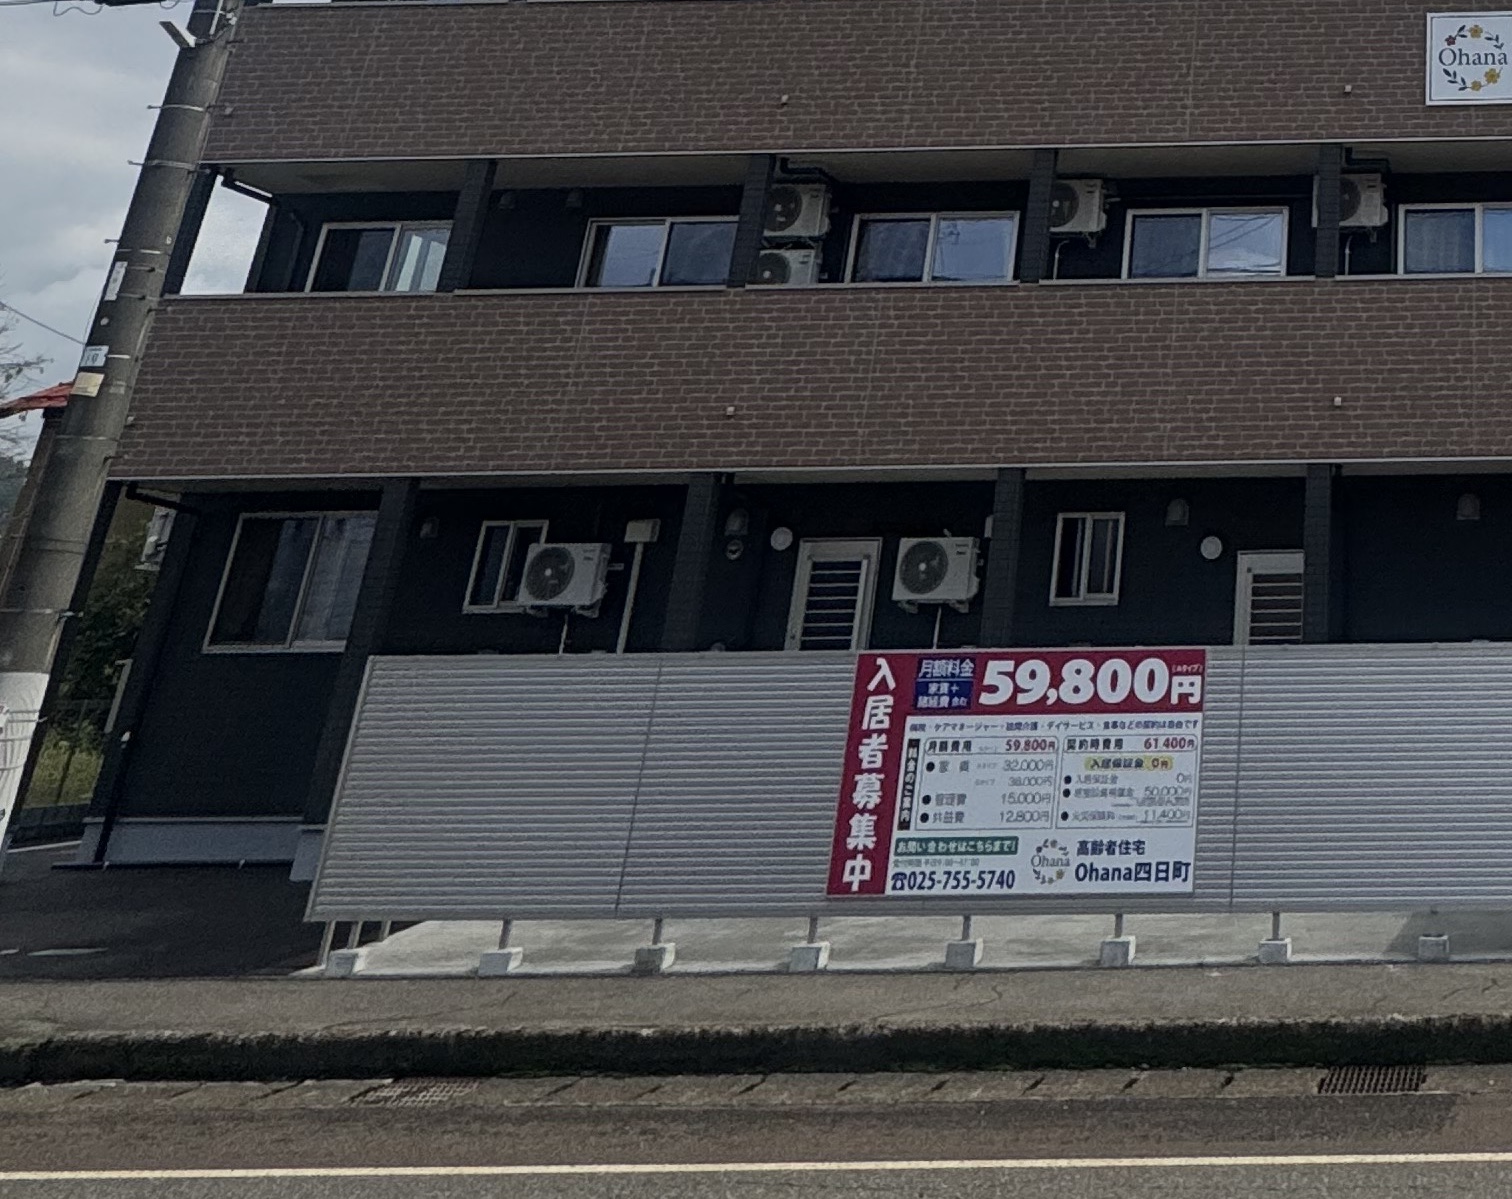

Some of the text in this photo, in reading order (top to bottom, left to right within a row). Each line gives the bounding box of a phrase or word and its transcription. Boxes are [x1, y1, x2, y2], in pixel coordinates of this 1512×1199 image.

[1438, 47, 1508, 67] Ohana
[918, 658, 975, 678] 月額料金
[842, 657, 896, 892] 入居者募集中
[1077, 840, 1146, 856] 高齢者住宅
[1030, 855, 1070, 868] Ohana
[1074, 861, 1191, 882] Ohana四日町
